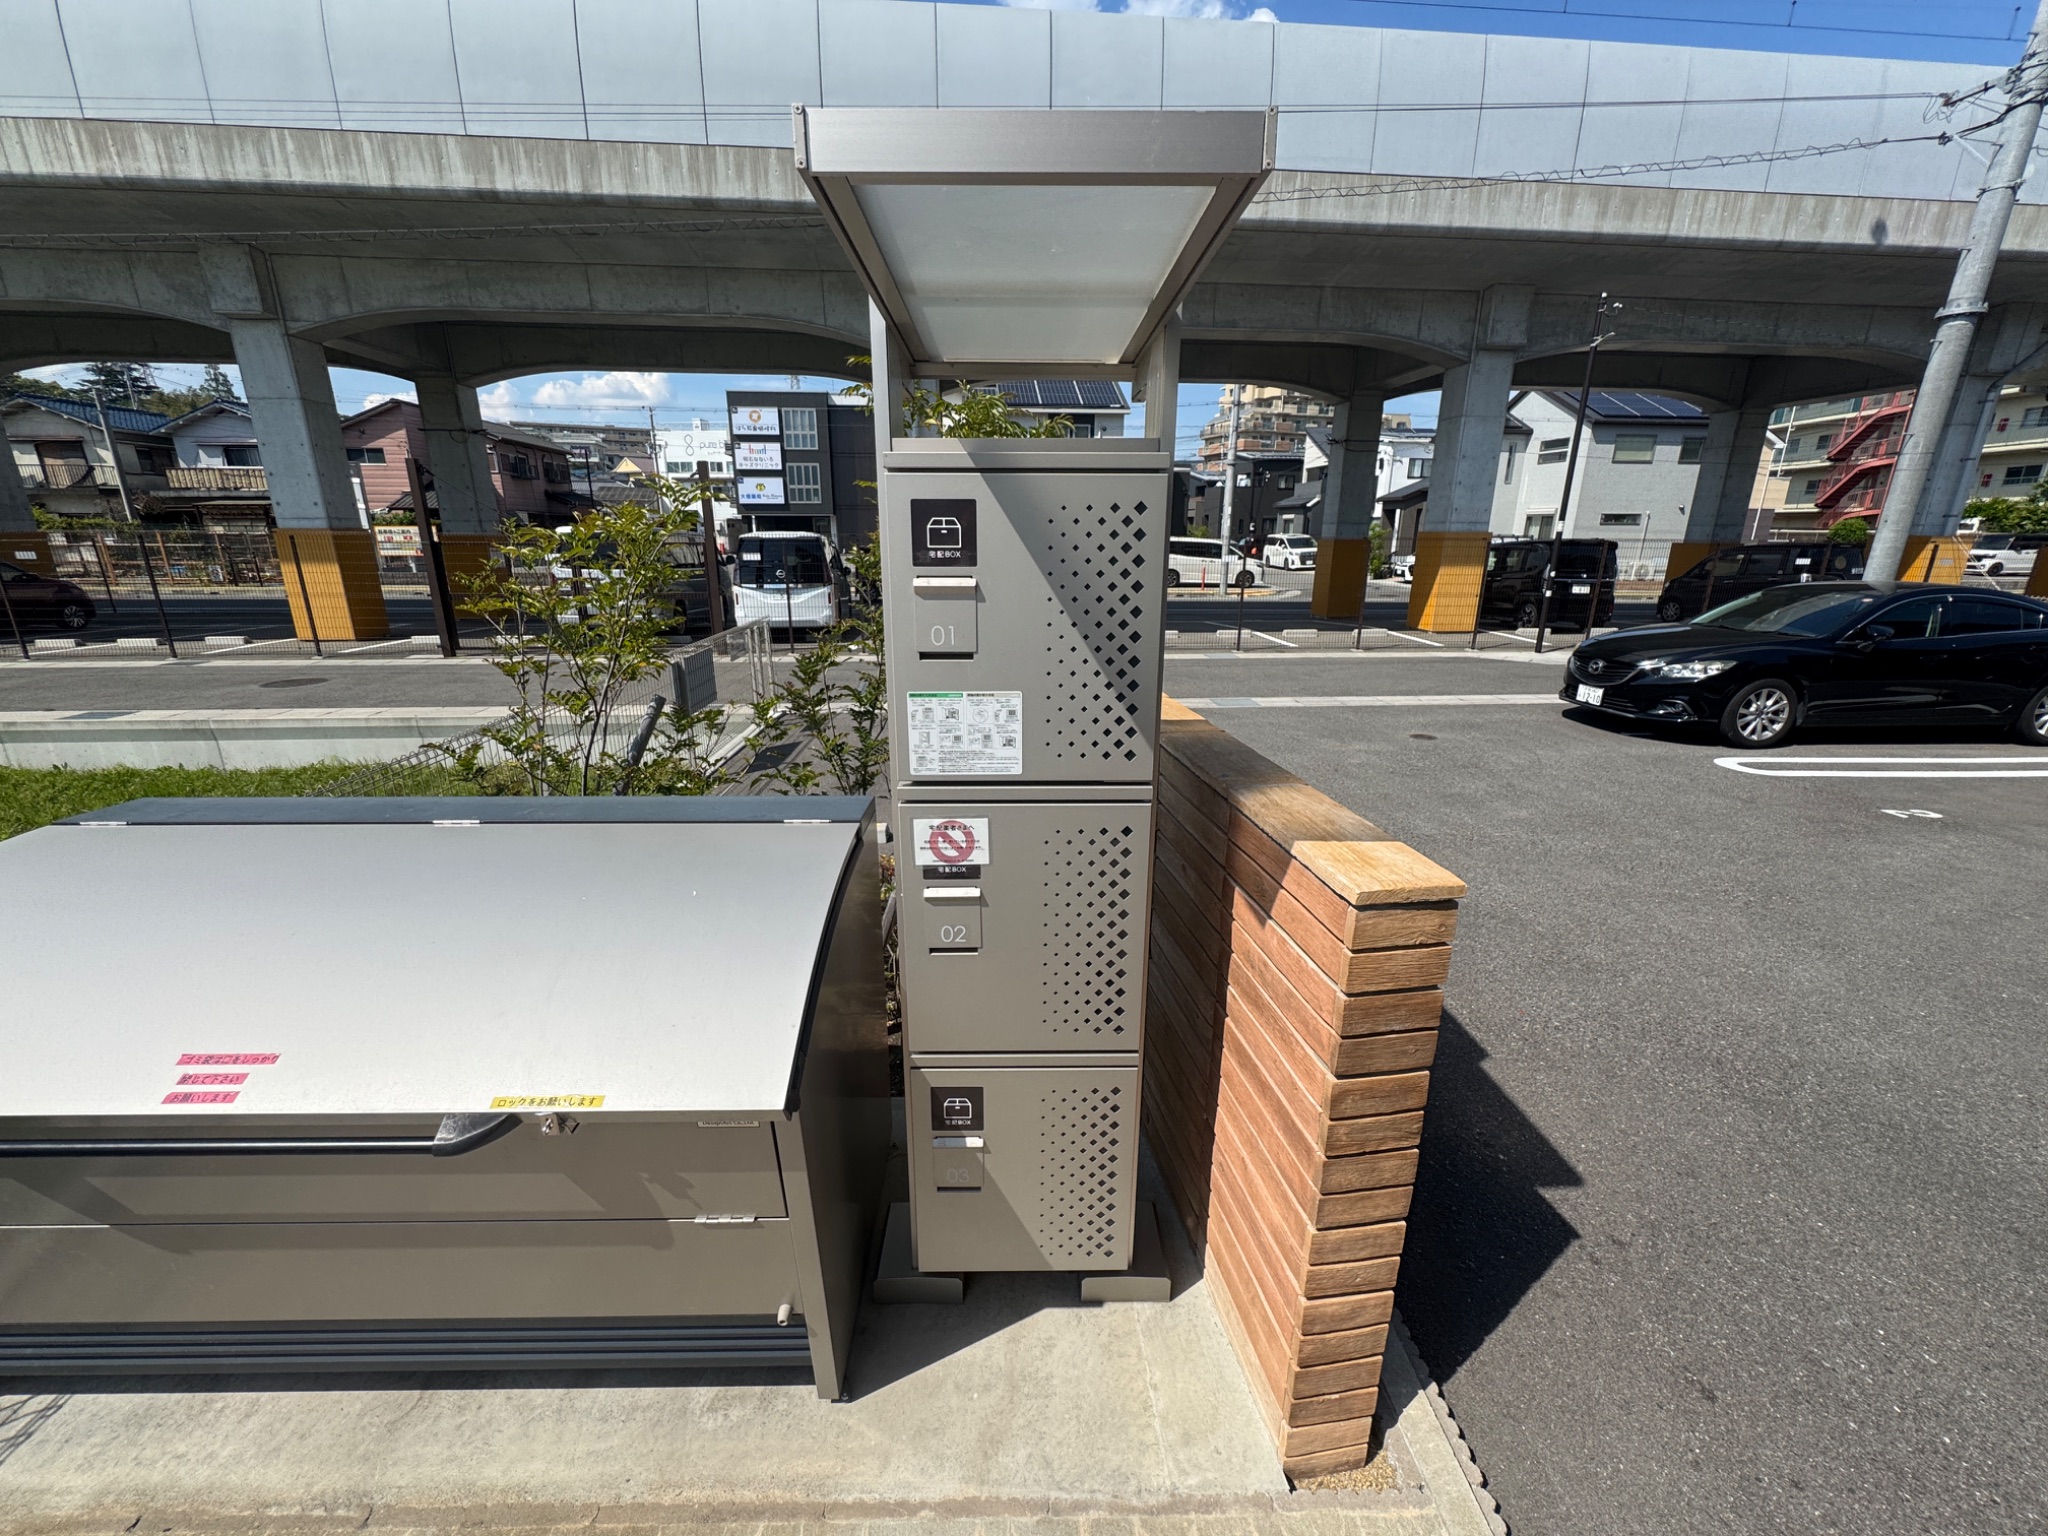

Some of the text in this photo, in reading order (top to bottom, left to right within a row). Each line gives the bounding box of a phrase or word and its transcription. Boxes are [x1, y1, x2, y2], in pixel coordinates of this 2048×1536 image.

[928, 550, 962, 558] 宅配BOX
[931, 625, 955, 646] 01
[929, 824, 975, 832] 宅配業者さまへ
[941, 925, 967, 943] 02
[169, 1093, 231, 1103] お願いします
[497, 1096, 598, 1107] ロックをお願いします
[946, 1167, 970, 1184] 03
